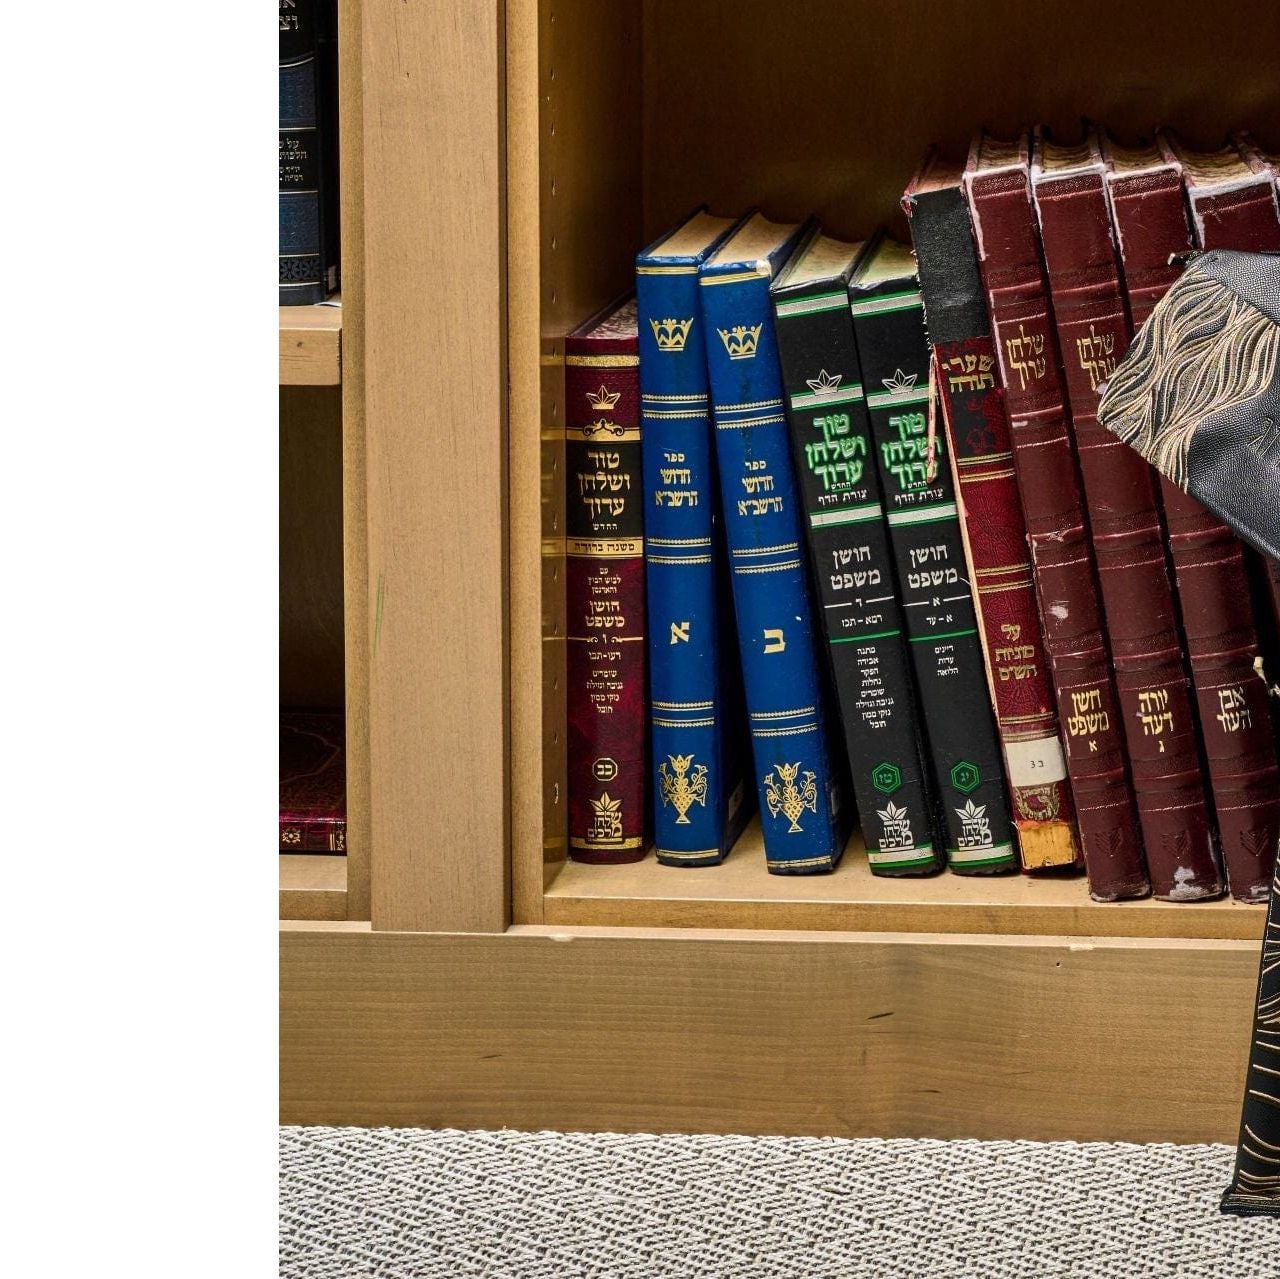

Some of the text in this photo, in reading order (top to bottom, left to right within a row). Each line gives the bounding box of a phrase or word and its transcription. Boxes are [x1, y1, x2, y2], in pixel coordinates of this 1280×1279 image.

[1006, 324, 1044, 365] שלחן
[942, 354, 994, 374] שערי
[588, 452, 620, 469] טור
[664, 453, 686, 462] ספר
[804, 435, 867, 470] ושלחן
[745, 460, 766, 470] ספר
[814, 460, 864, 491] ערוך
[578, 472, 630, 496] ושלחן
[660, 468, 691, 485] חדושי
[742, 475, 774, 493] חדושי
[583, 498, 625, 519] ערוך
[818, 489, 868, 506] צורת הדף
[574, 542, 634, 552] משנה ברורה
[832, 546, 870, 570] חושן
[910, 544, 948, 568] חושן
[830, 569, 881, 591] משפט
[908, 568, 958, 590] משפט
[590, 601, 620, 615] חושן
[933, 598, 940, 606] א
[585, 616, 625, 628] משפט
[670, 622, 690, 645] א
[763, 628, 786, 654] ב
[1072, 688, 1102, 715] חשן
[1138, 690, 1168, 712] יורה
[1218, 687, 1246, 714] אבן
[1068, 711, 1110, 736] משפט
[1142, 711, 1174, 736] דעה
[1089, 740, 1098, 752] א
[1159, 740, 1164, 753] ג
